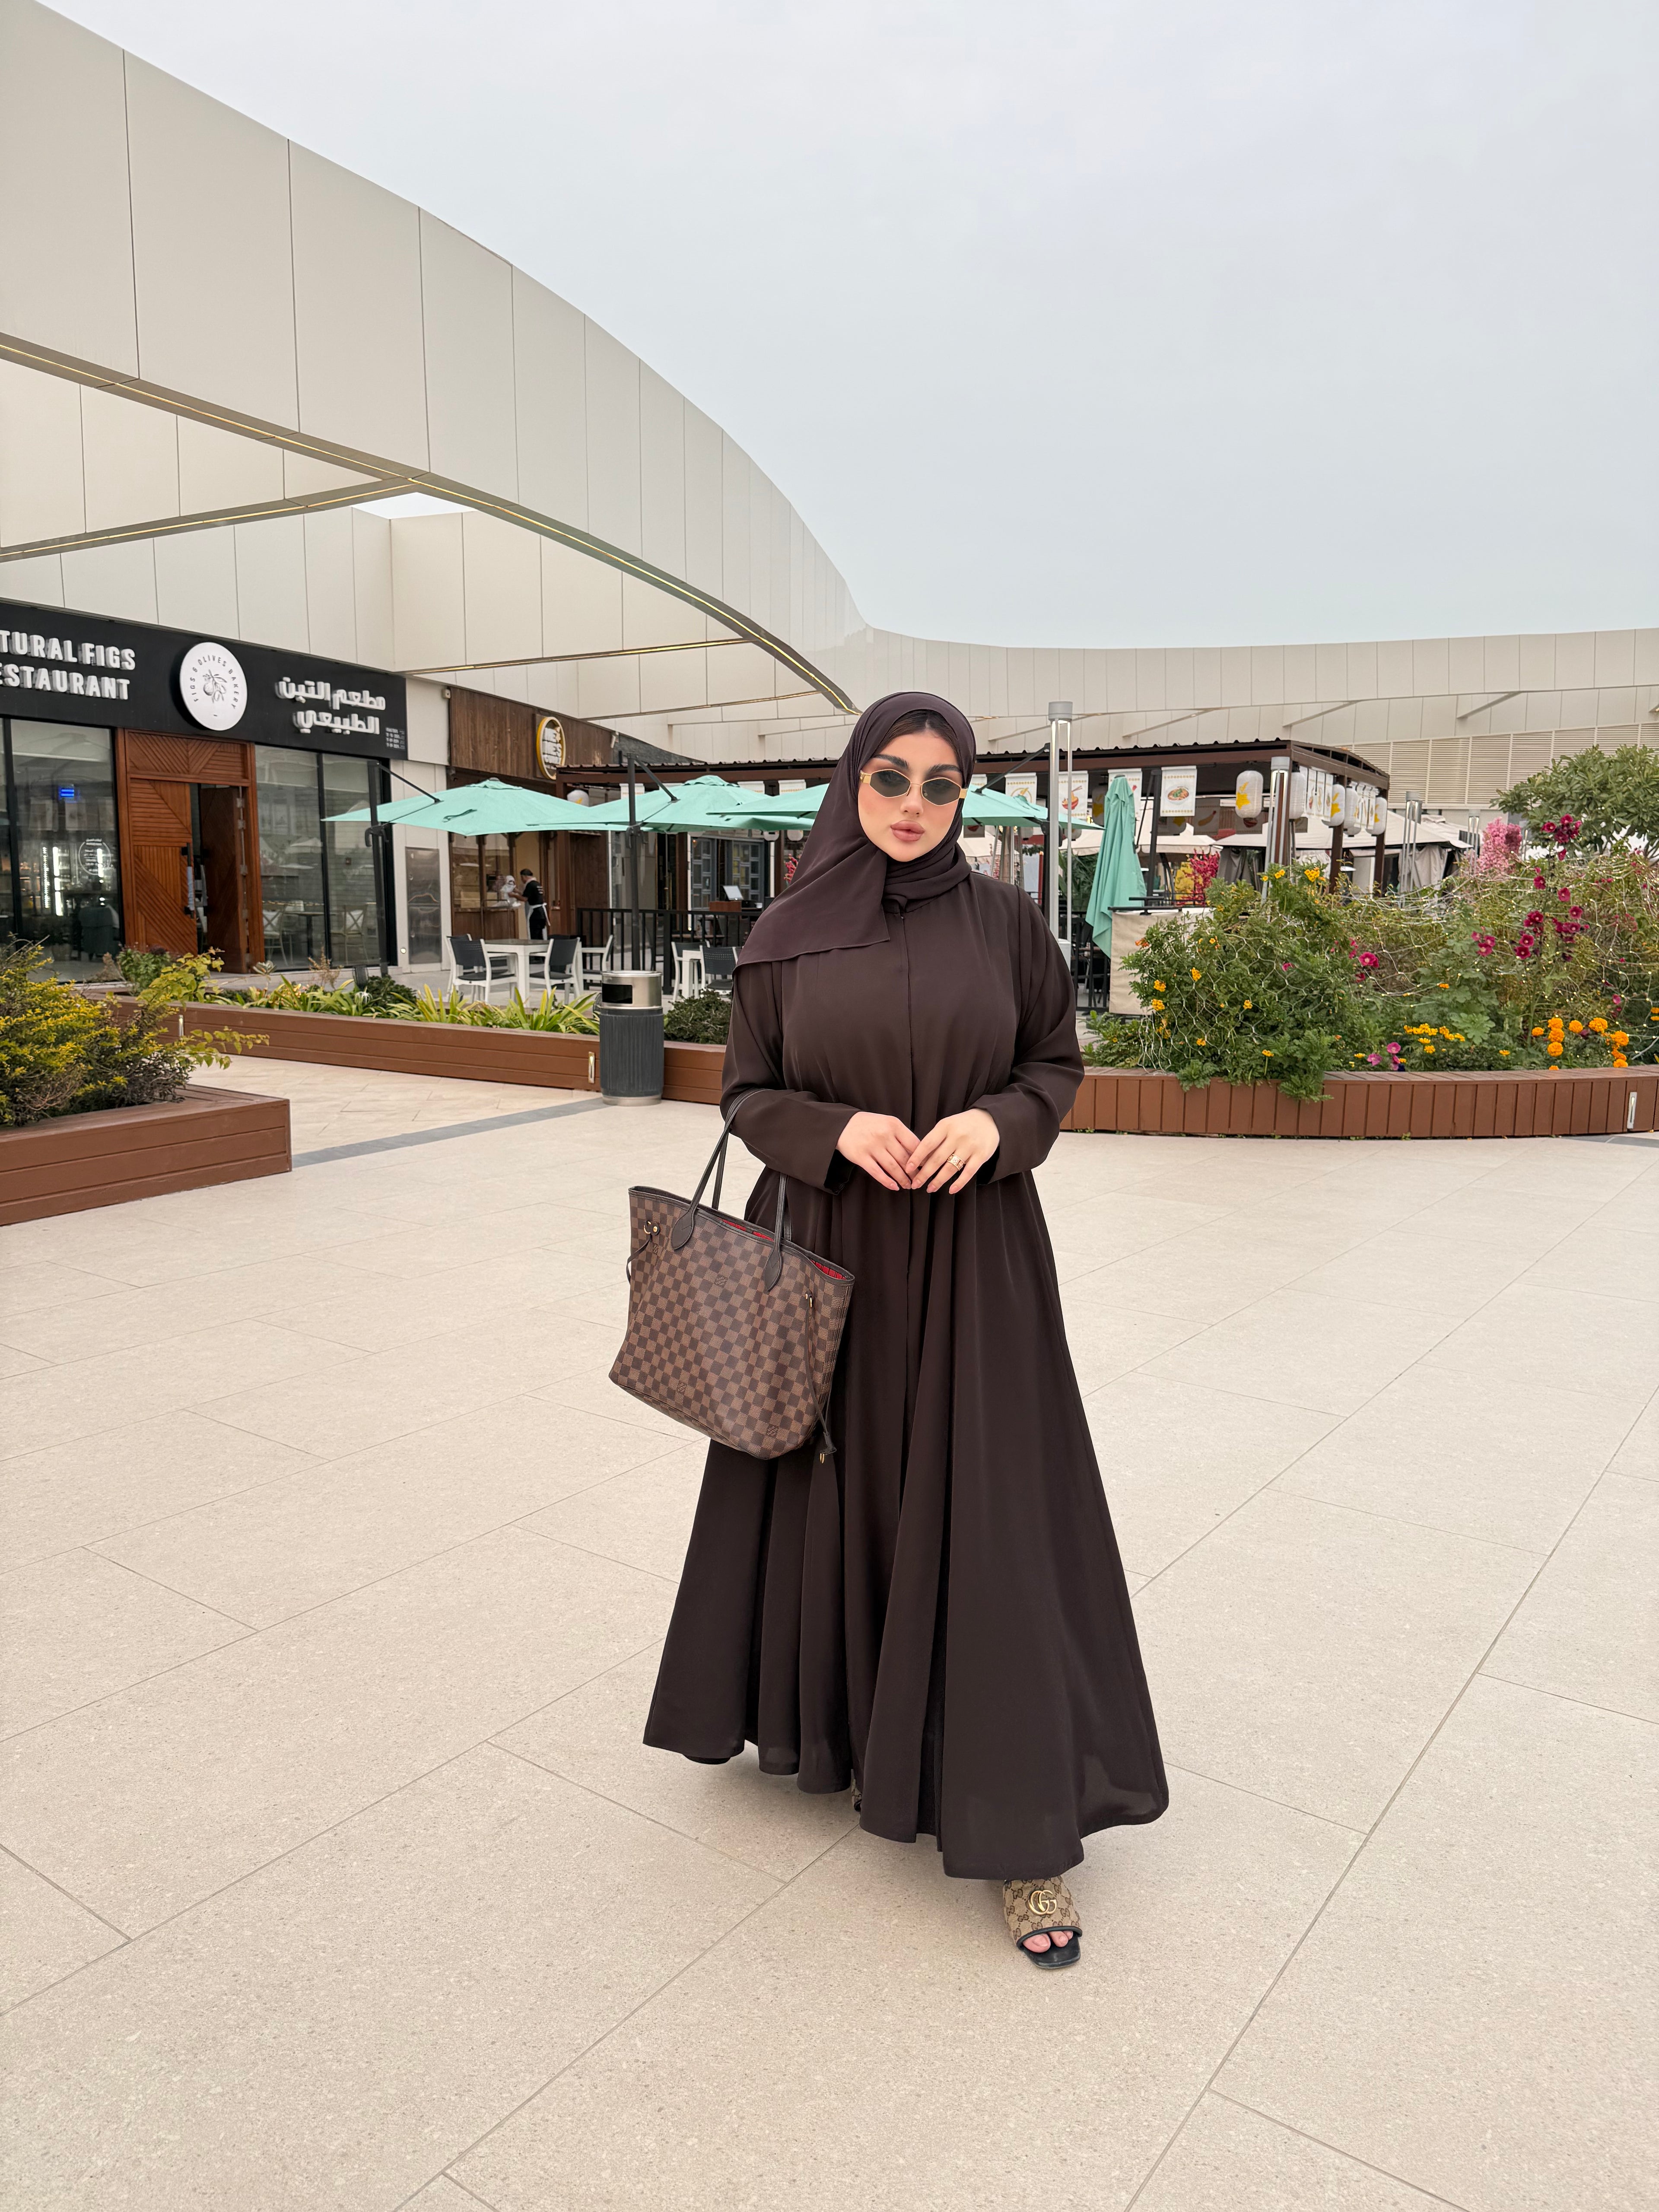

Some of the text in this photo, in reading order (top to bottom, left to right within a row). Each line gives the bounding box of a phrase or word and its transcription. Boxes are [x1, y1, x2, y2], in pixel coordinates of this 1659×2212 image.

[80, 642, 135, 670] FIGS
[0, 662, 130, 700] STAURANT
[197, 655, 227, 667] OLIVES
[228, 669, 239, 709] BAKERY
[278, 676, 386, 711] مطعم التين
[296, 710, 380, 735] الطبيعي
